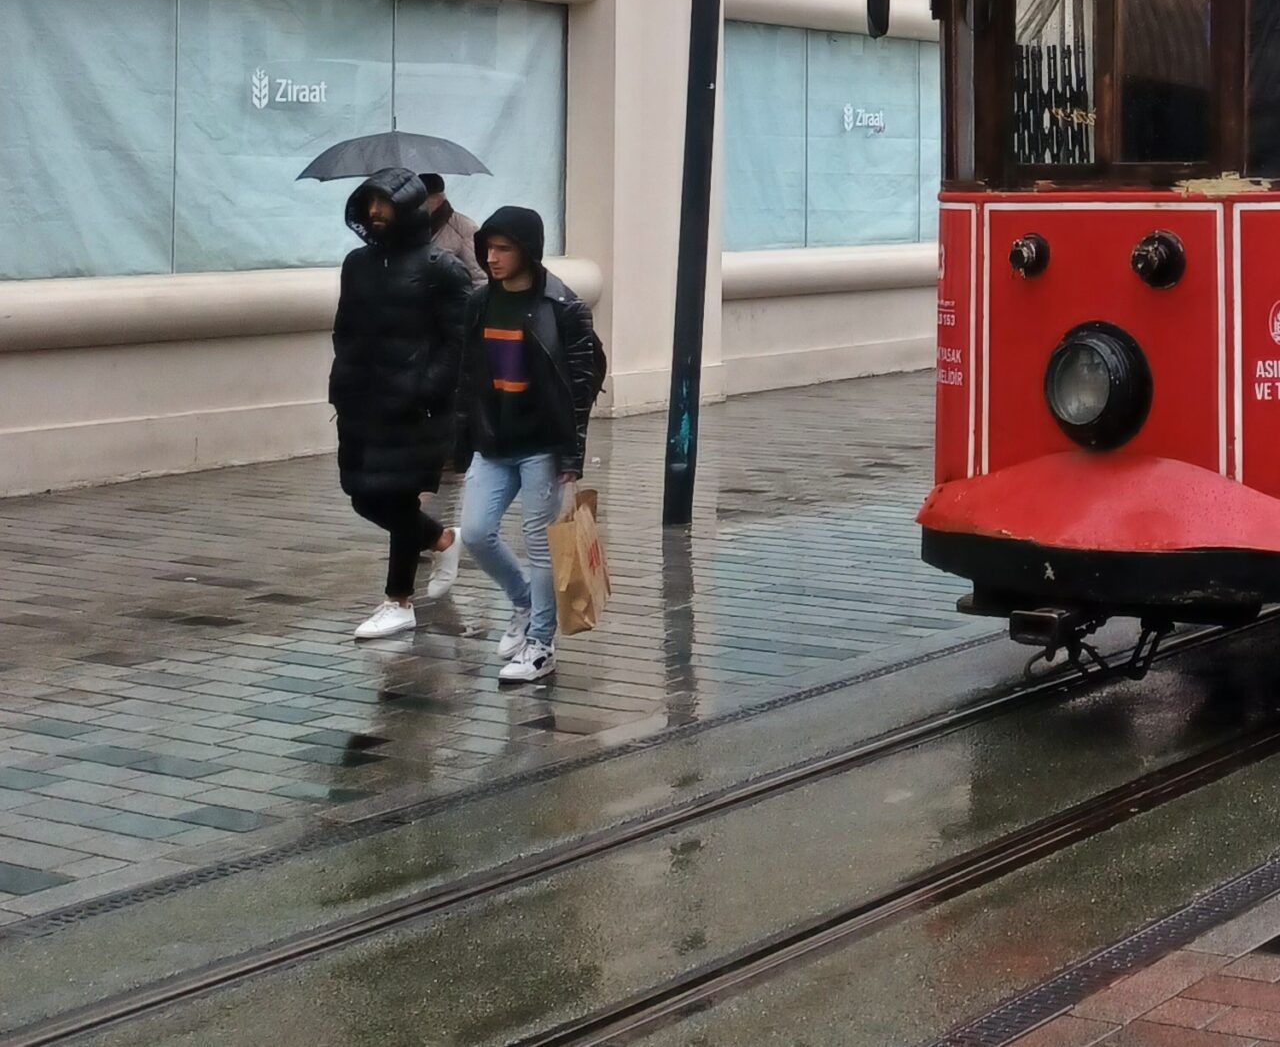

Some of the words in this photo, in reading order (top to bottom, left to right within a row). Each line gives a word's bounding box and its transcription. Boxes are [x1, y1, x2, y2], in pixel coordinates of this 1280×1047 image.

[275, 78, 328, 103] Ziraat
[855, 108, 884, 127] Ziraat
[1254, 382, 1273, 401] VE
